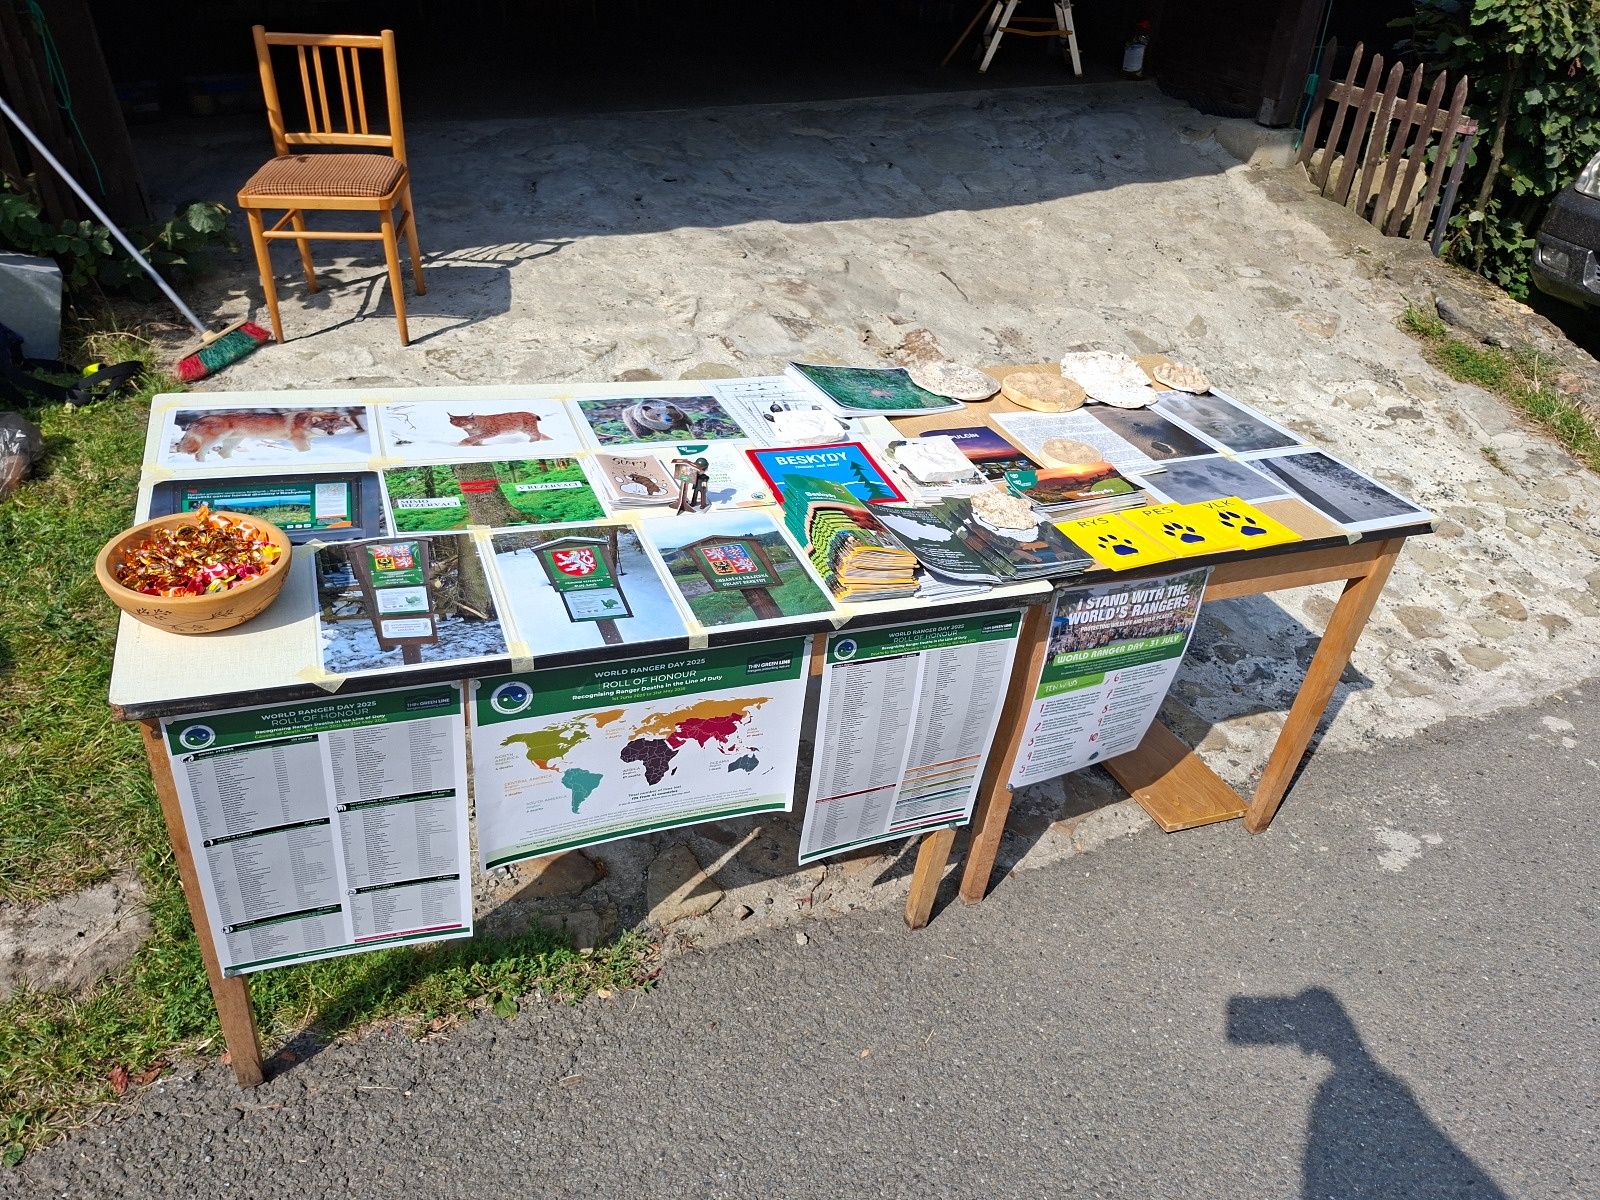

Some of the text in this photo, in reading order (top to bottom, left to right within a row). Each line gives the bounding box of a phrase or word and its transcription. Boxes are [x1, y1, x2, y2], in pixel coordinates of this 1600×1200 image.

[774, 452, 848, 465] BESKYDY
[1203, 500, 1235, 510] VLK
[1142, 506, 1174, 517] PES
[1077, 518, 1110, 528] RYS
[1076, 583, 1188, 610] I STAND WITH THE
[1068, 595, 1190, 625] WORLD'S RANGERS
[1080, 623, 1110, 632] PROTECTING
[1155, 613, 1173, 621] PLACES
[913, 627, 937, 635] RANGER
[925, 630, 958, 639] HONOUR
[1057, 652, 1089, 663] WORLD
[1091, 645, 1126, 658] RANGER
[1127, 642, 1144, 651] DAY
[1160, 635, 1180, 645] JULY
[594, 669, 628, 678] WORLD
[630, 664, 666, 674] RANGER
[668, 661, 685, 669] DAY
[603, 670, 697, 689] ROLL OF HONOUR
[1114, 673, 1120, 682] 6
[572, 691, 614, 701] Recognising
[616, 687, 640, 696] Ranger
[641, 683, 664, 691] Deaths
[261, 712, 296, 720] WORLD
[298, 706, 335, 715] RANGER
[1040, 704, 1044, 713] 1
[272, 718, 301, 726] ROLL
[321, 708, 369, 719] HONOUR
[256, 726, 291, 735] Recognising
[1034, 722, 1041, 732] 2
[1028, 738, 1034, 746] 3
[1089, 733, 1098, 742] 10
[1019, 765, 1026, 773] 5
